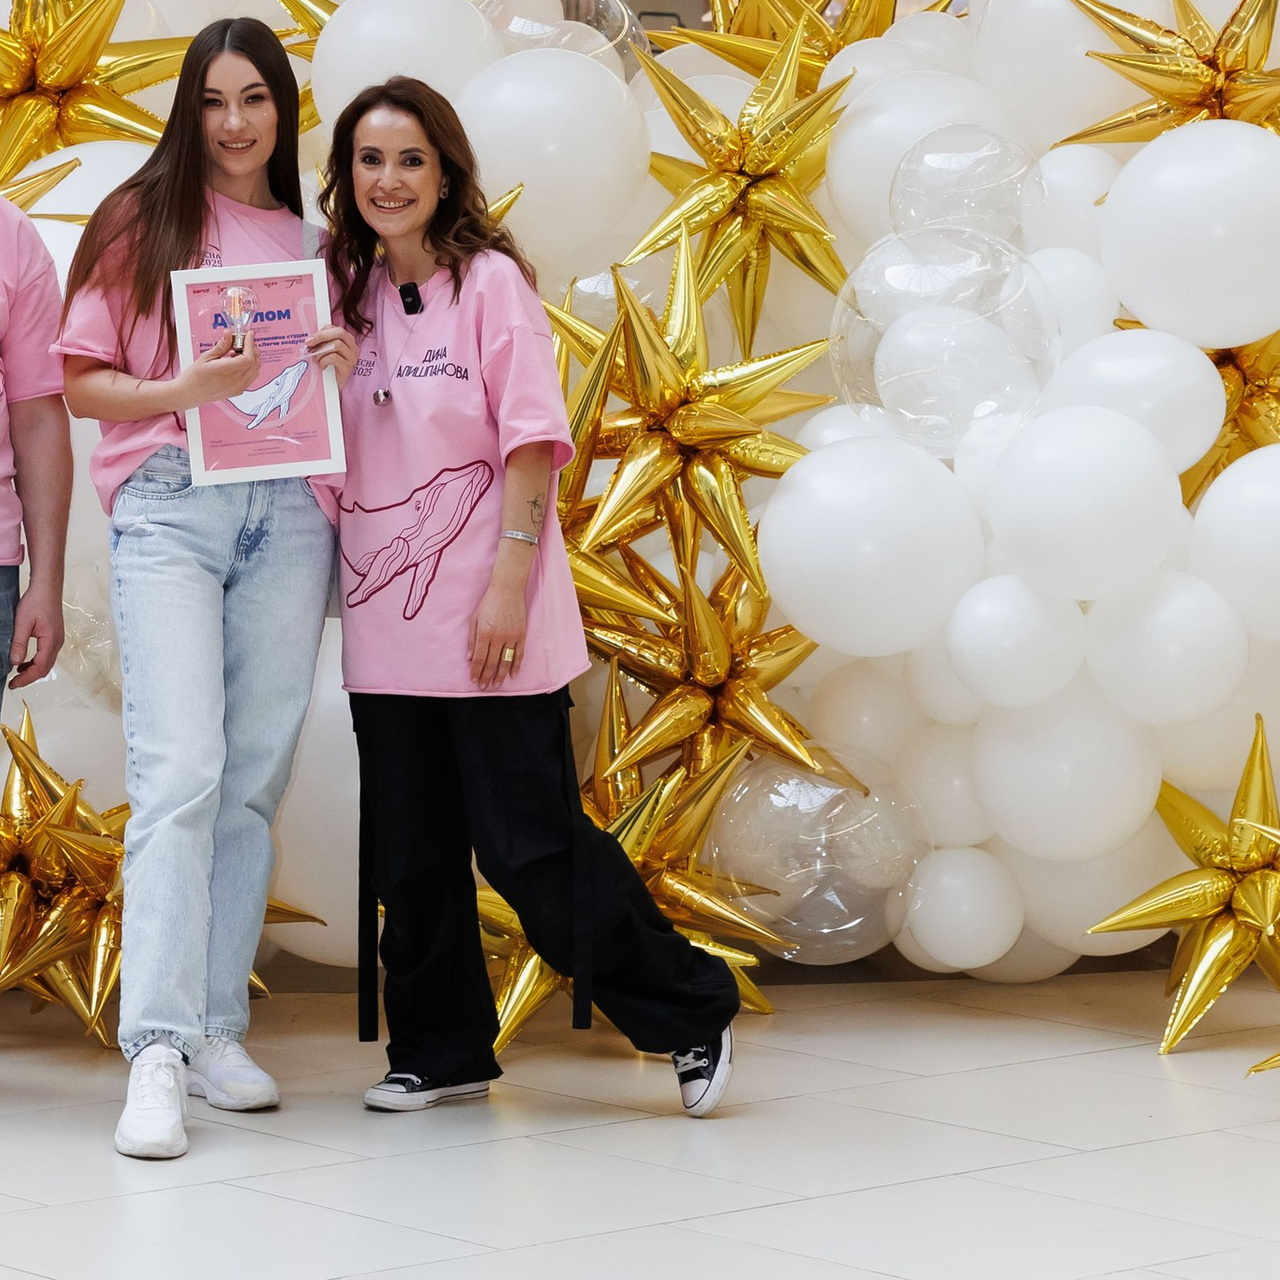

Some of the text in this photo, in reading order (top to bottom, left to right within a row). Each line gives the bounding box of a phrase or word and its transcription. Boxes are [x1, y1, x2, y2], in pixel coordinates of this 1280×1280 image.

[212, 309, 291, 329] Длом
[356, 358, 375, 368] ЕСНА
[422, 346, 447, 364] ДИНА
[396, 362, 469, 381] АЛИШПАНОВА
